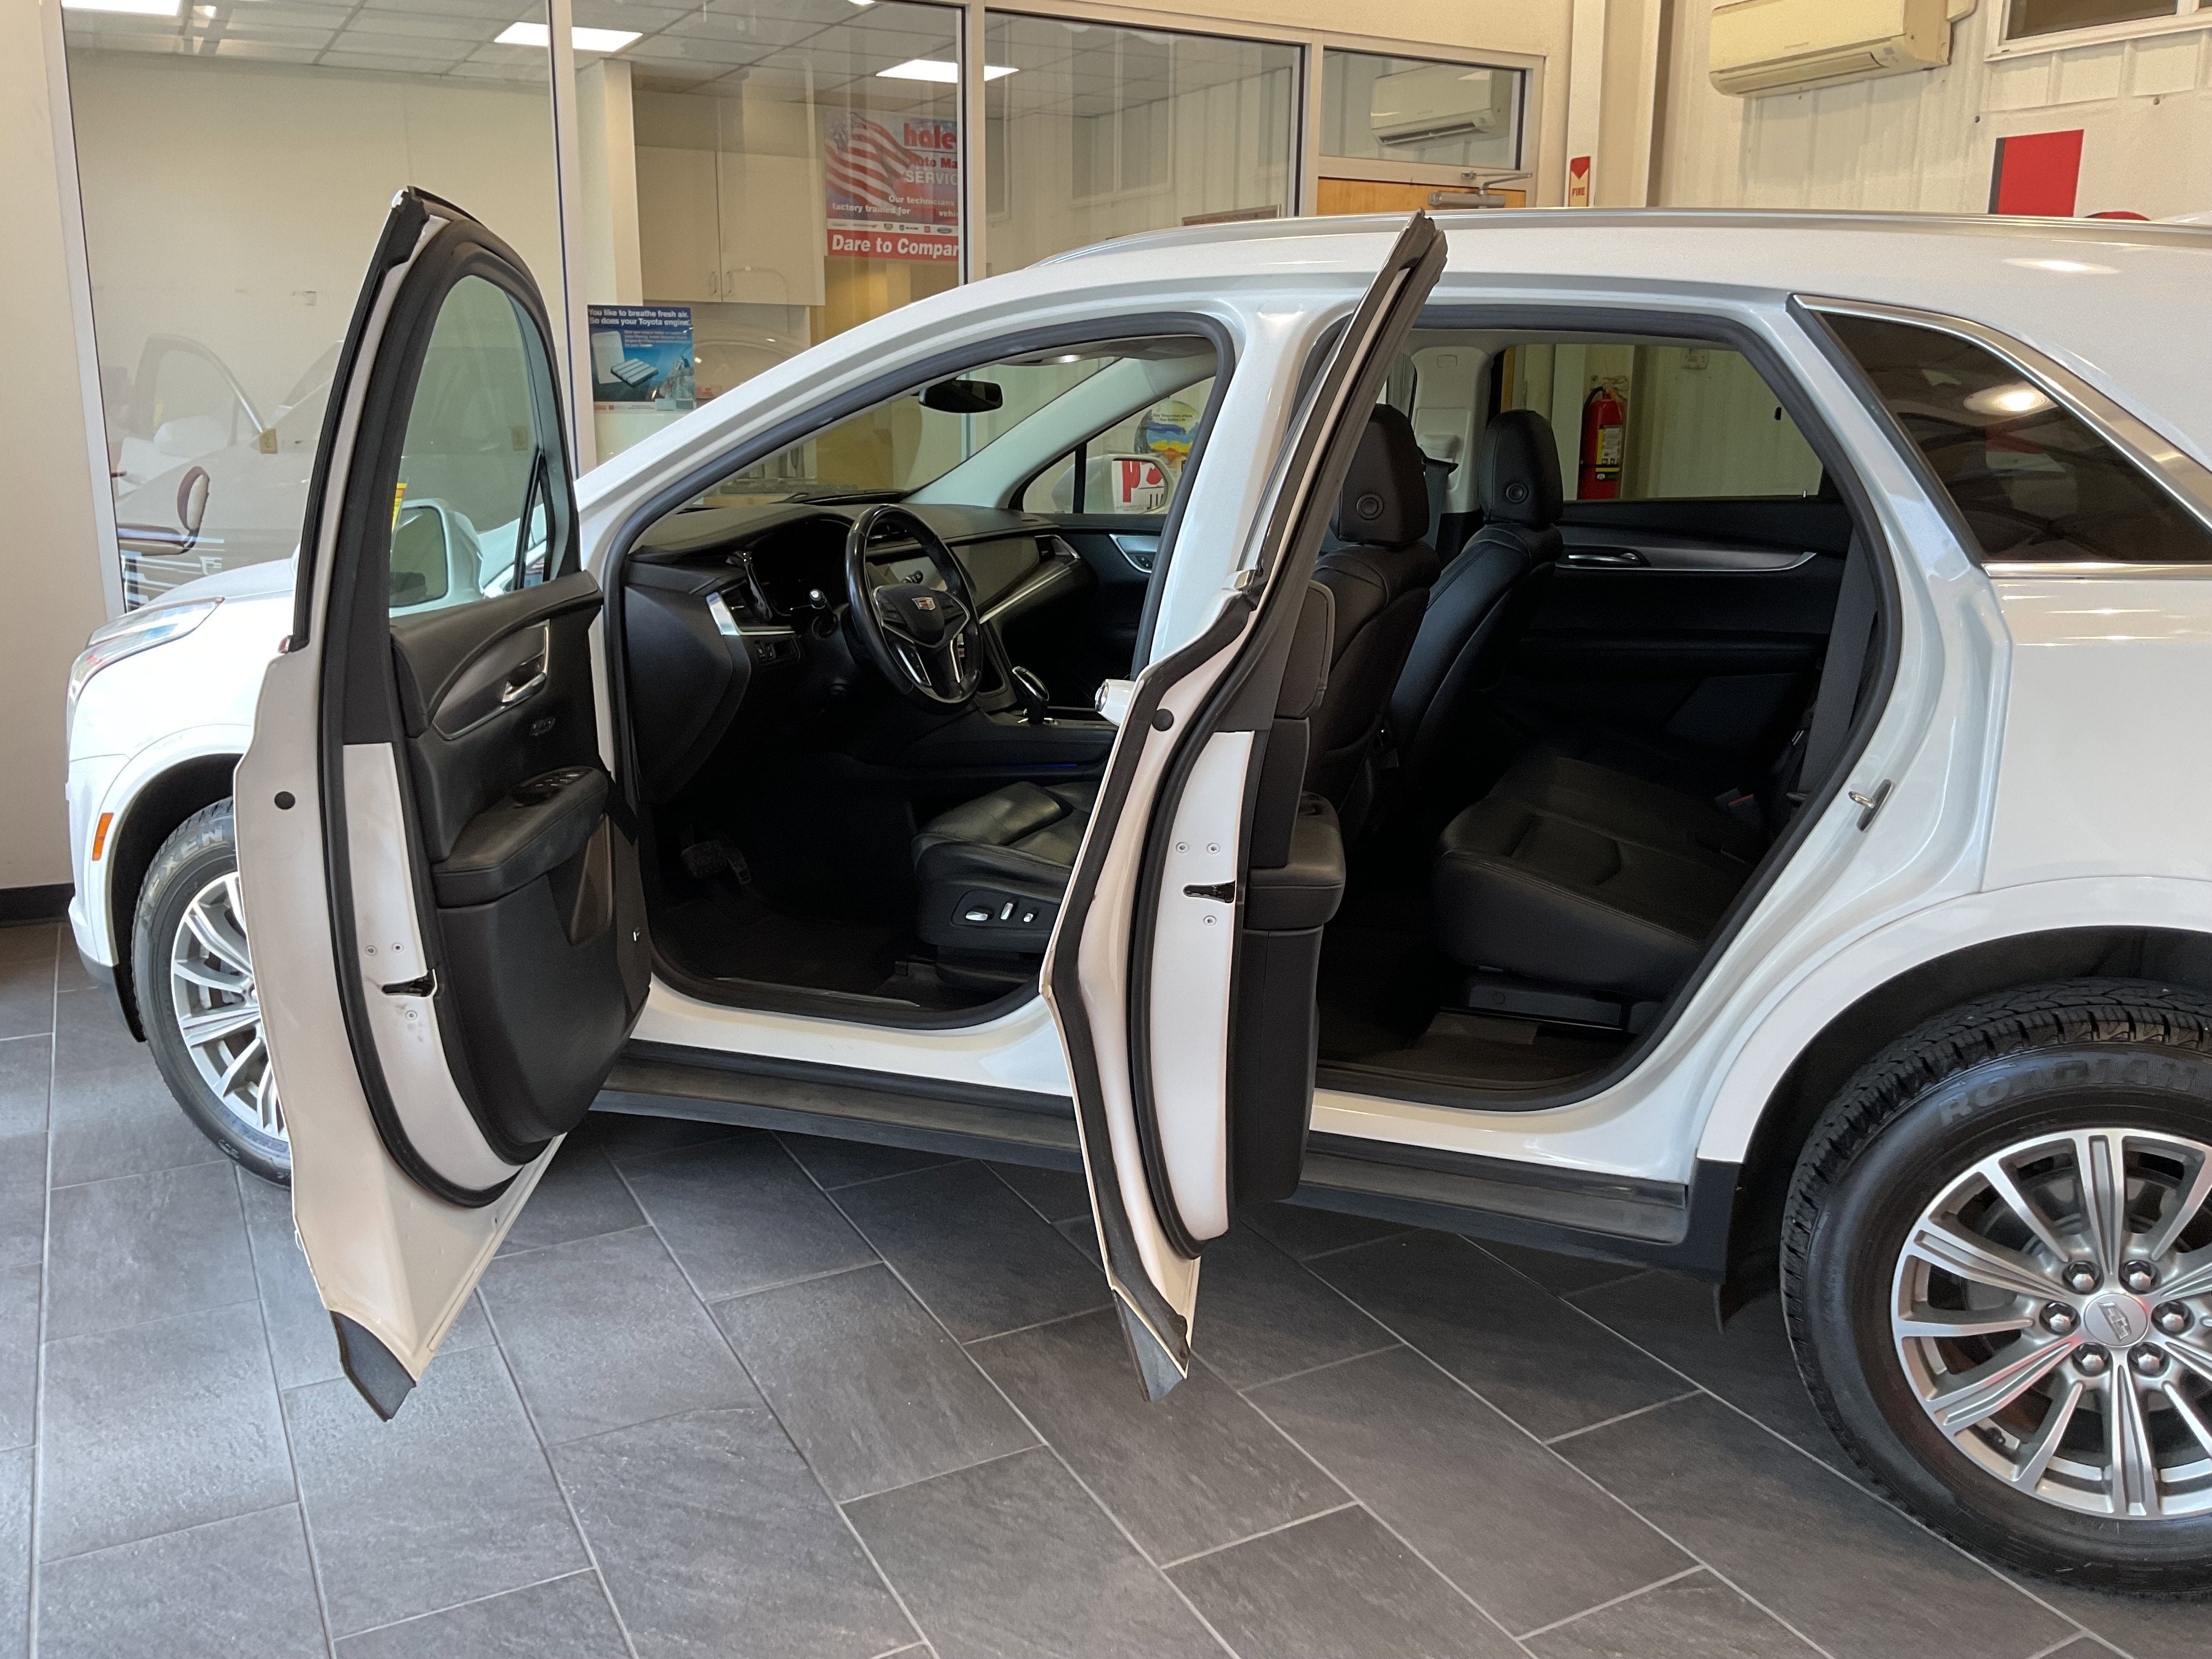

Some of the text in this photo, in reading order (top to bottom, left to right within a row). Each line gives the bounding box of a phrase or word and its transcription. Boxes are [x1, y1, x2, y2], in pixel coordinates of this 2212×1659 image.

[904, 122, 957, 150] hale
[1572, 187, 1585, 197] FIRE
[888, 195, 955, 206] Our technicians
[832, 202, 863, 213] factory
[865, 205, 896, 214] trained
[898, 206, 910, 215] for
[832, 234, 958, 258] Dare to Compar
[638, 318, 663, 326] Toyota
